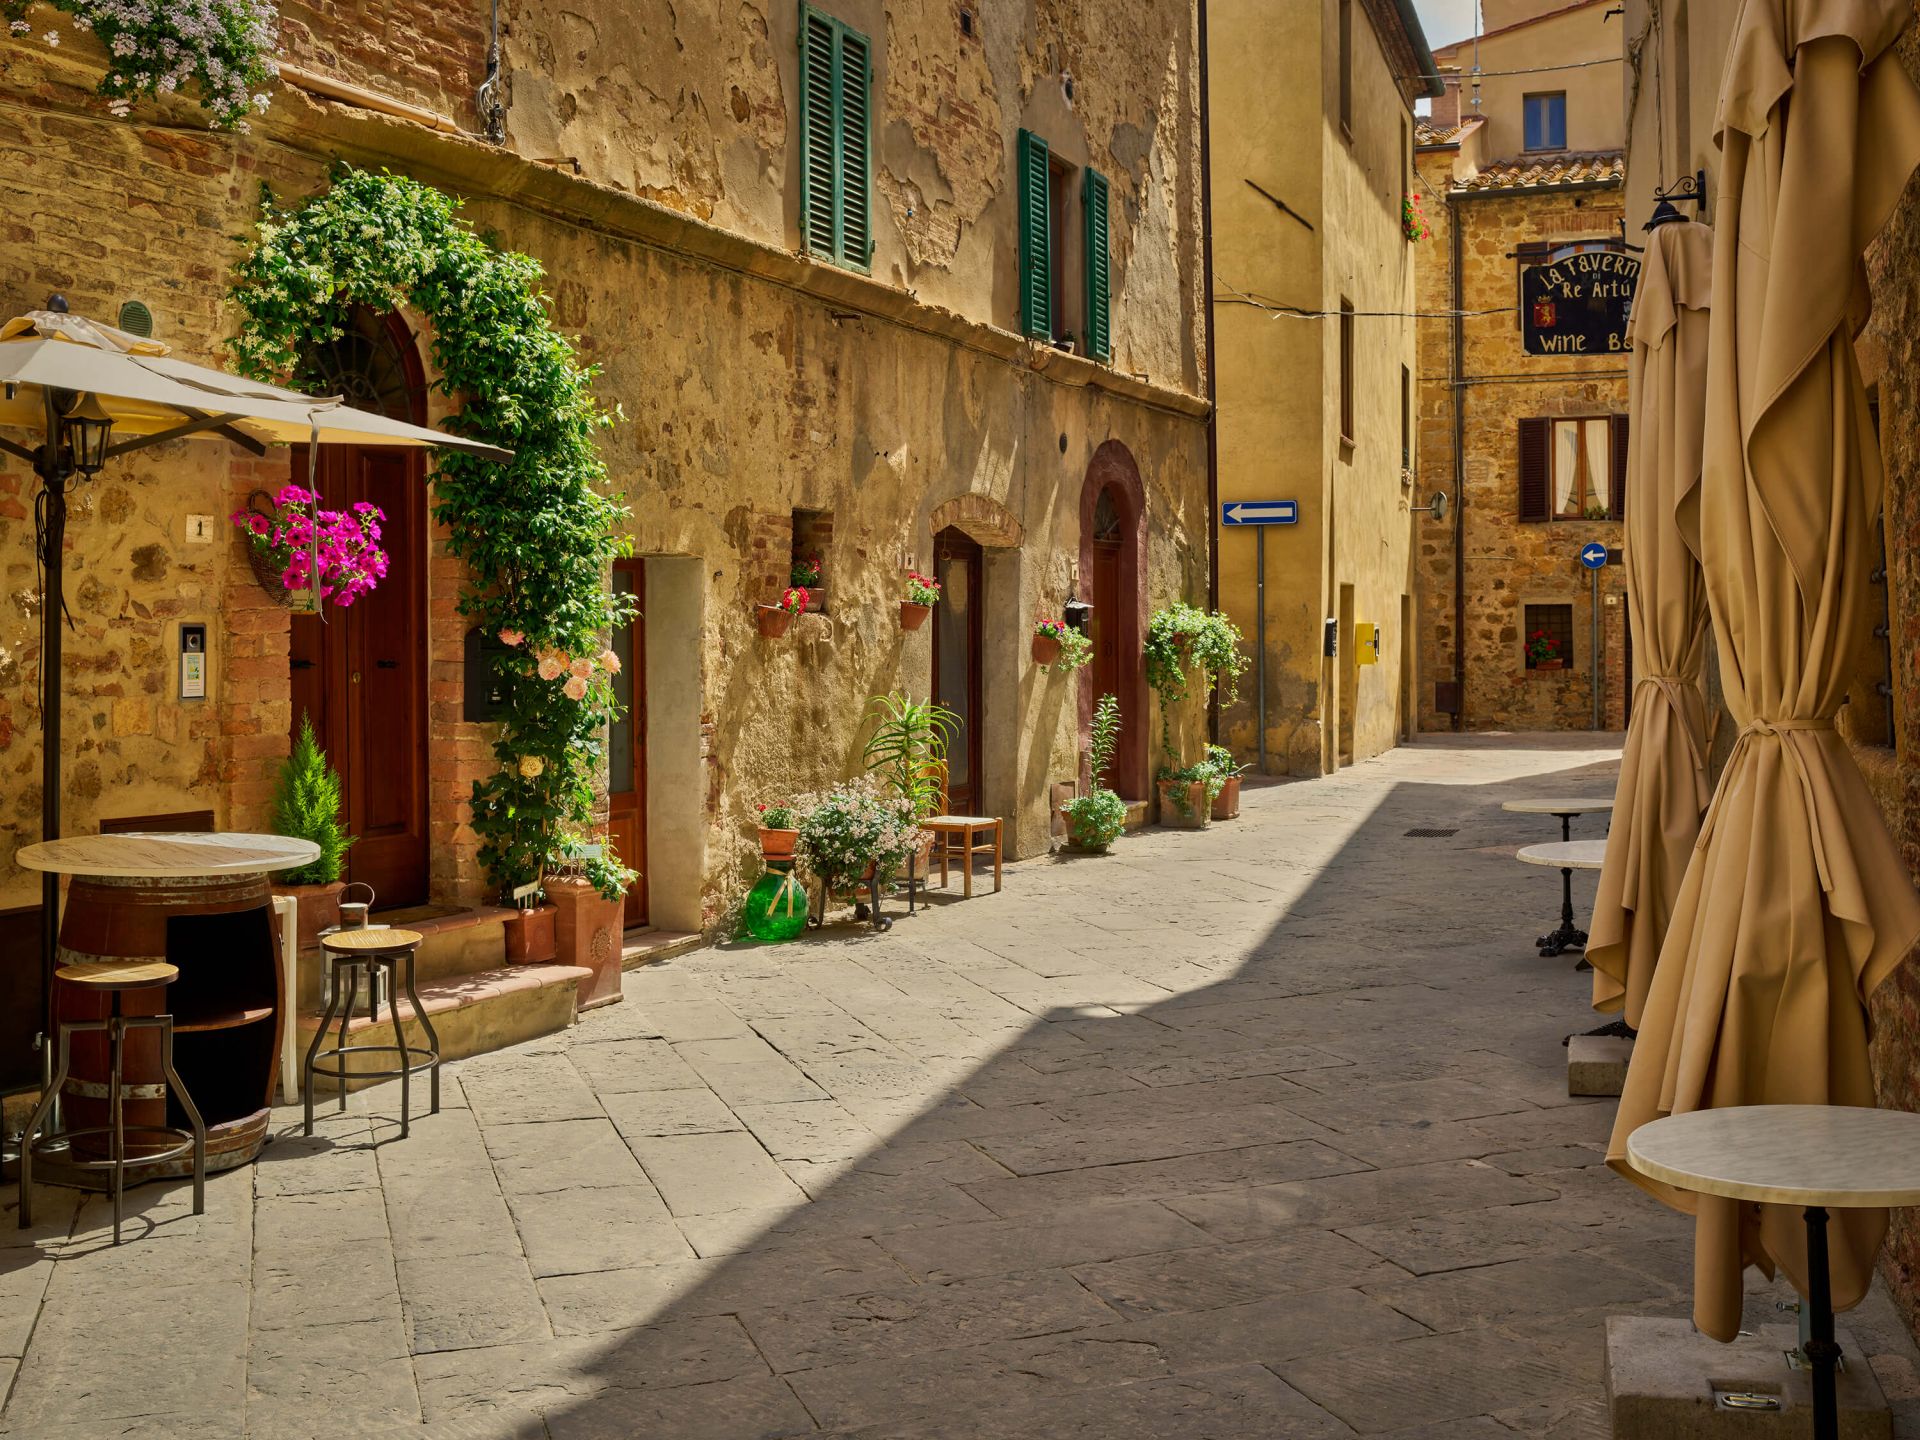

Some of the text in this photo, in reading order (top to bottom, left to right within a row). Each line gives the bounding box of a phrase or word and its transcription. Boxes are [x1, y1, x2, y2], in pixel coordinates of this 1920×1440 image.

[1540, 267, 1565, 291] La
[1563, 282, 1582, 298] Re
[1540, 334, 1587, 353] Wine
[196, 520, 203, 537] 1
